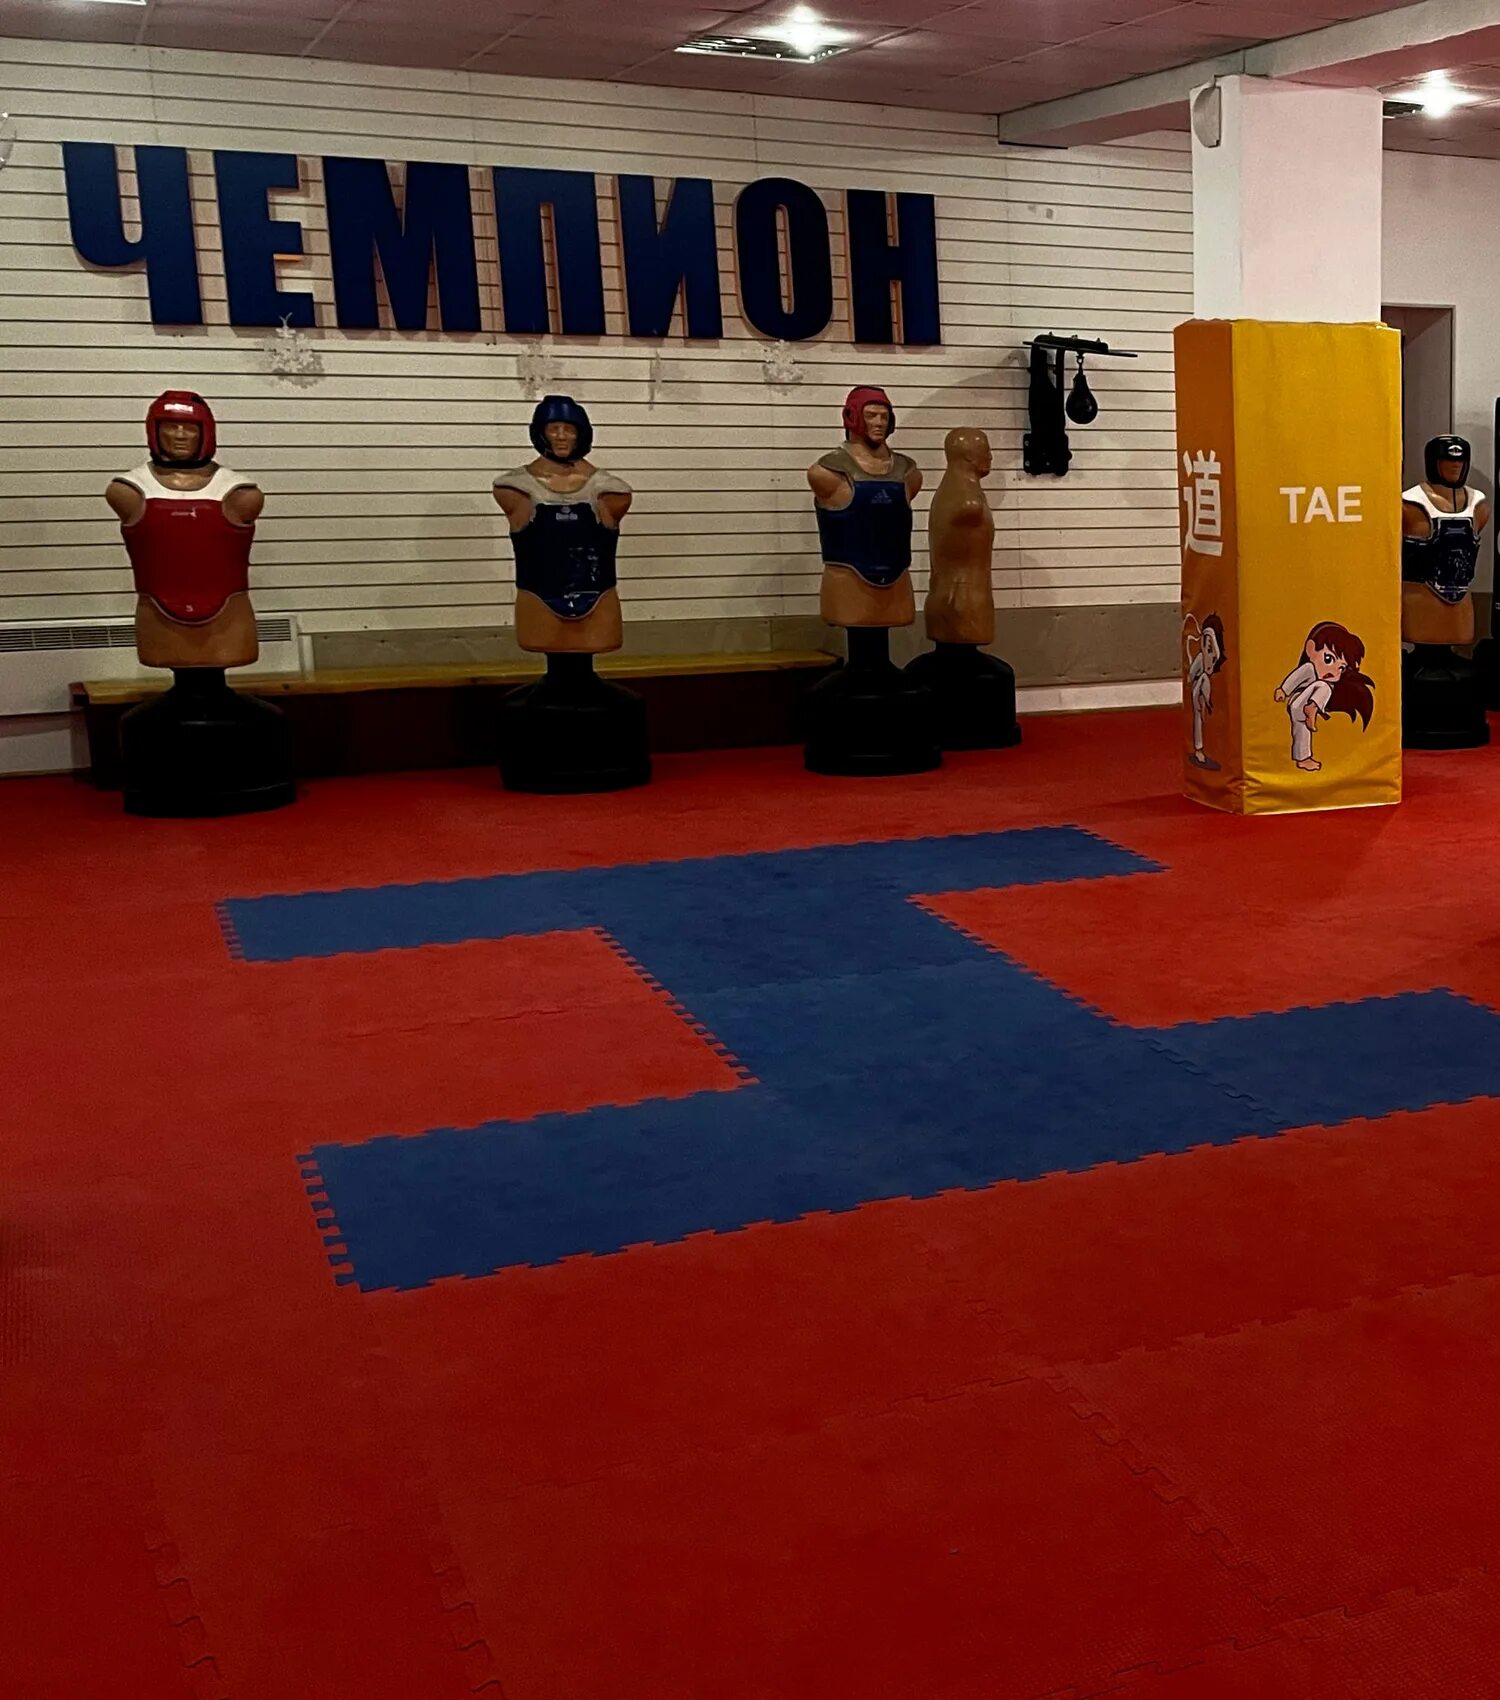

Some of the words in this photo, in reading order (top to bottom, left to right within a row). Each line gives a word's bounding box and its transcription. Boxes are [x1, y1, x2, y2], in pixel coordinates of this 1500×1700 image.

[62, 142, 941, 345] ЧЕМПИОН
[1183, 450, 1223, 557] 道
[1279, 486, 1363, 523] TAE
